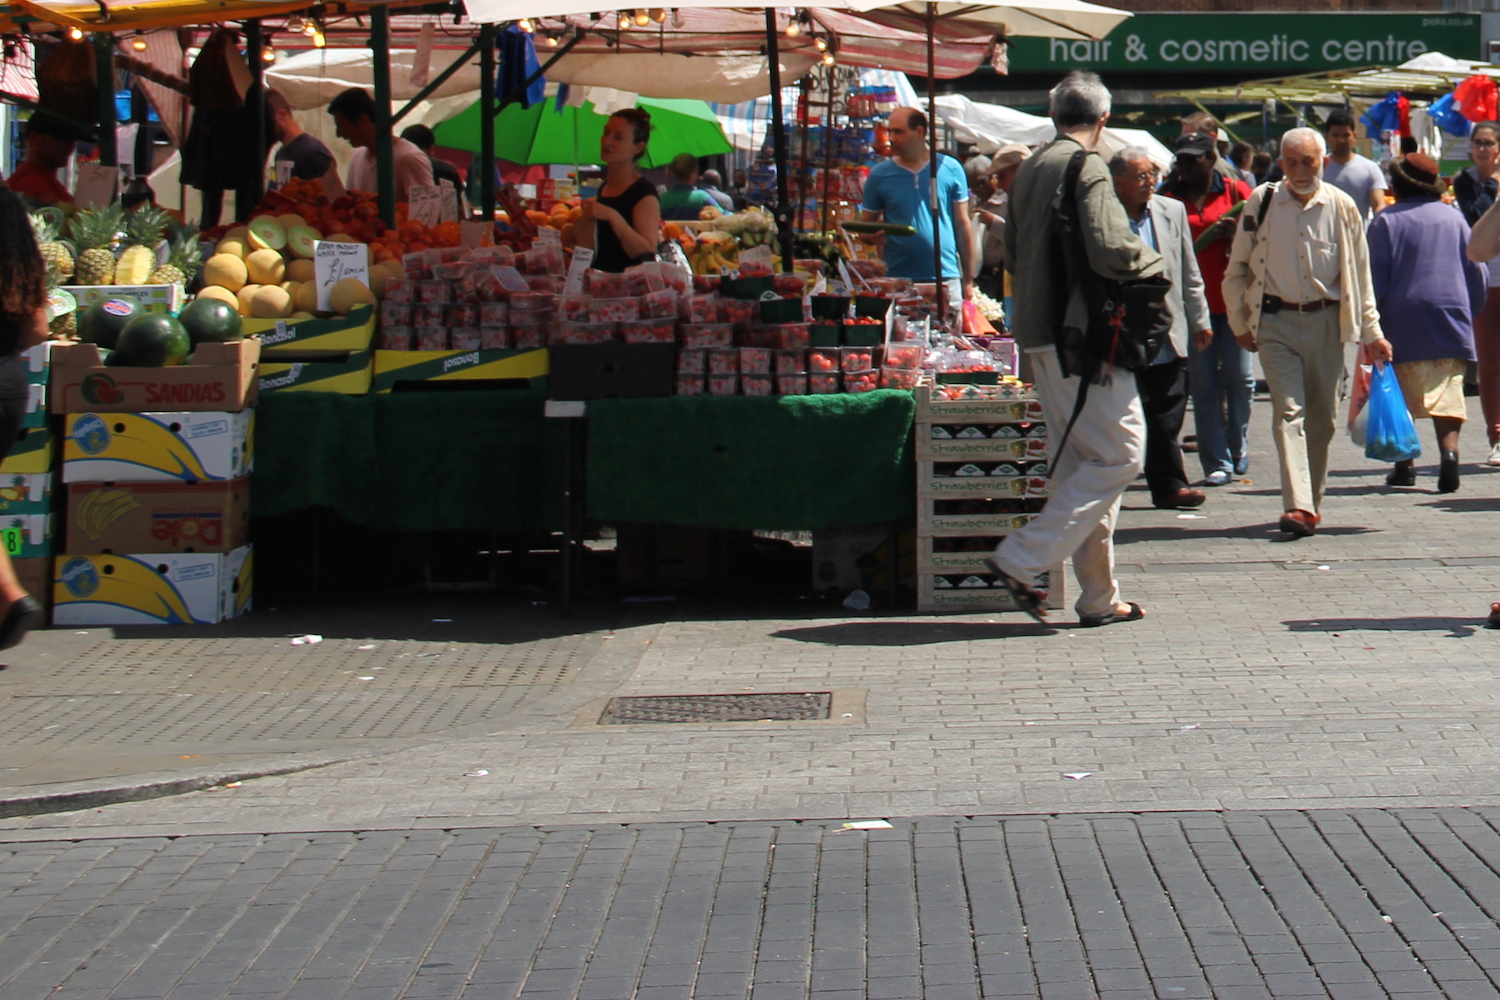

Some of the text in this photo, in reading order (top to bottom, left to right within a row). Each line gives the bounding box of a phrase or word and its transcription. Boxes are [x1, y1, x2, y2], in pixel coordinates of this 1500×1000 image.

[1049, 34, 1428, 63] hair & cosmetic centre
[443, 351, 480, 371] Bonasol
[145, 381, 226, 404] SANDIAS
[929, 404, 1008, 415] Strawberries
[930, 443, 1008, 454] Strawberries
[930, 480, 1009, 491] Strawberries
[931, 518, 1009, 529] Strawberries
[151, 519, 223, 547] Dole
[7, 531, 17, 552] 8
[931, 556, 984, 567] Strawbe
[932, 593, 1011, 604] Strawberries
